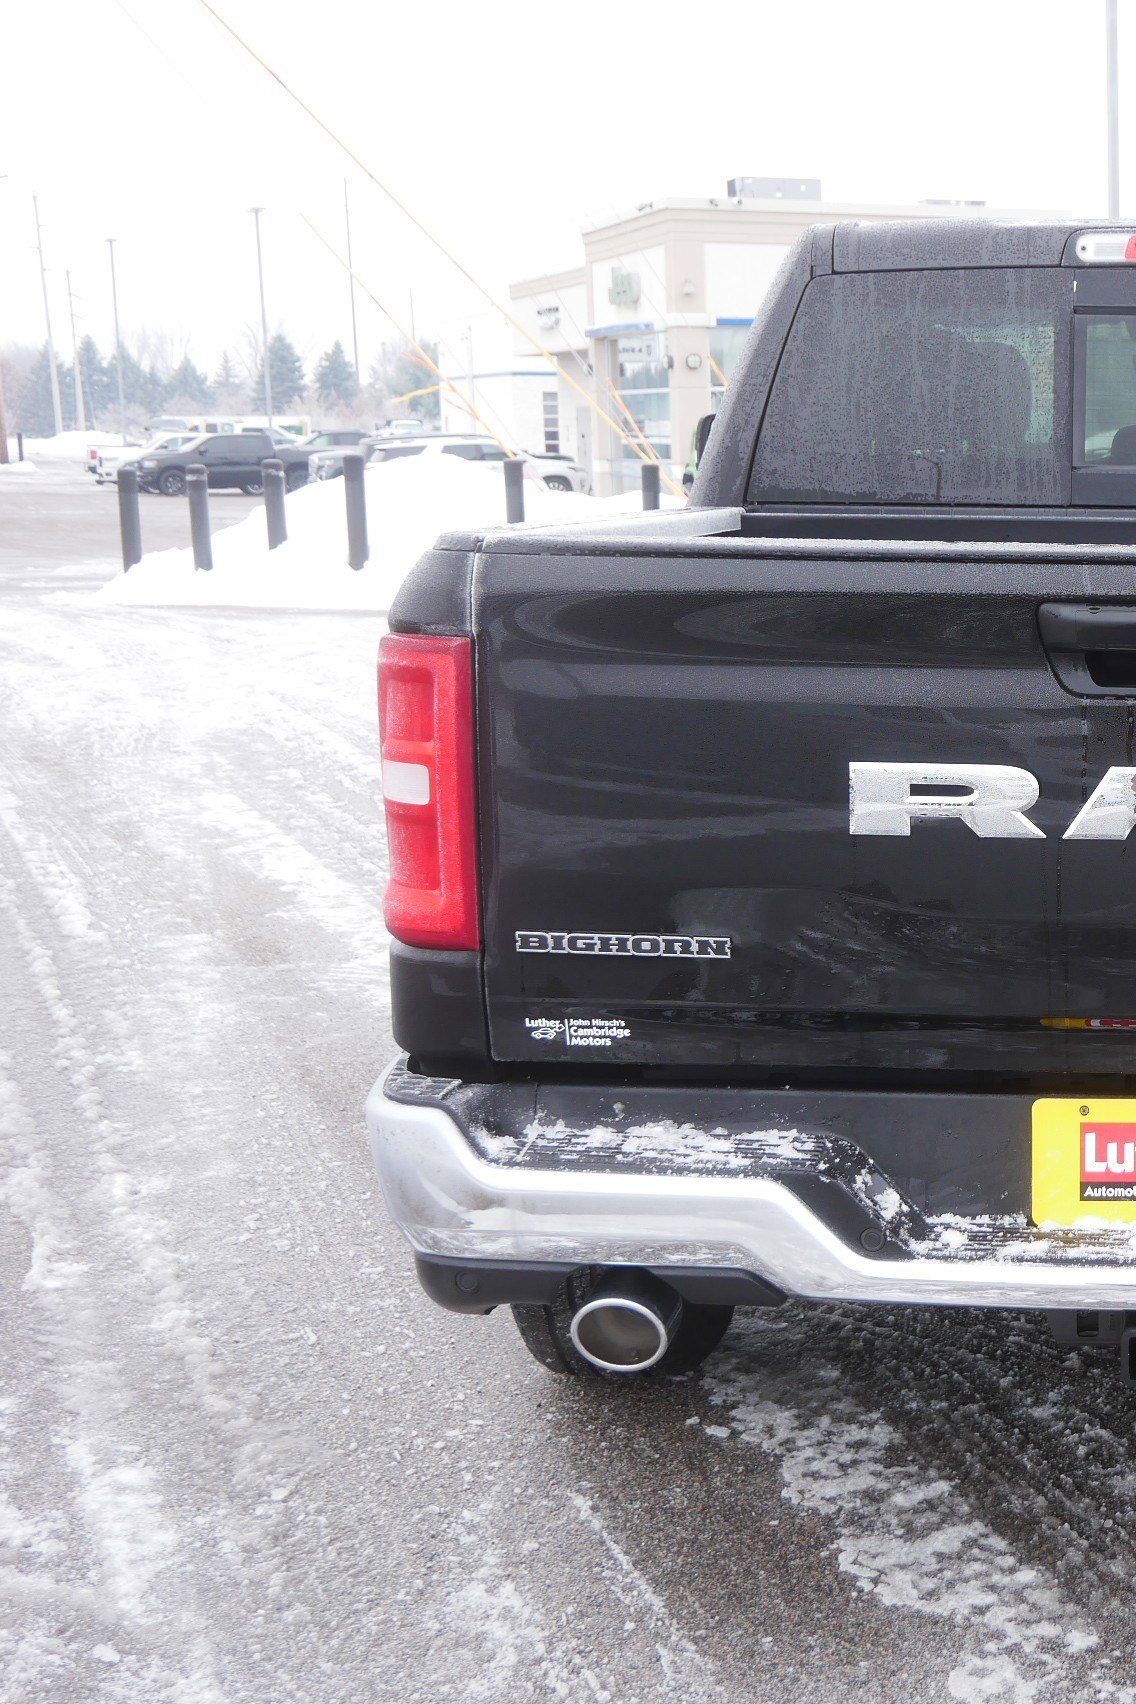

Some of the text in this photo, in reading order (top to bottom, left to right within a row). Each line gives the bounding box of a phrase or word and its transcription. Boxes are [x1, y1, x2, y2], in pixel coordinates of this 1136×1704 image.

[515, 930, 731, 959] BIGHORN
[525, 1017, 560, 1028] Luther
[569, 1018, 625, 1027] John Hirsch's
[570, 1026, 631, 1037] Cambridge
[571, 1036, 612, 1046] Motors
